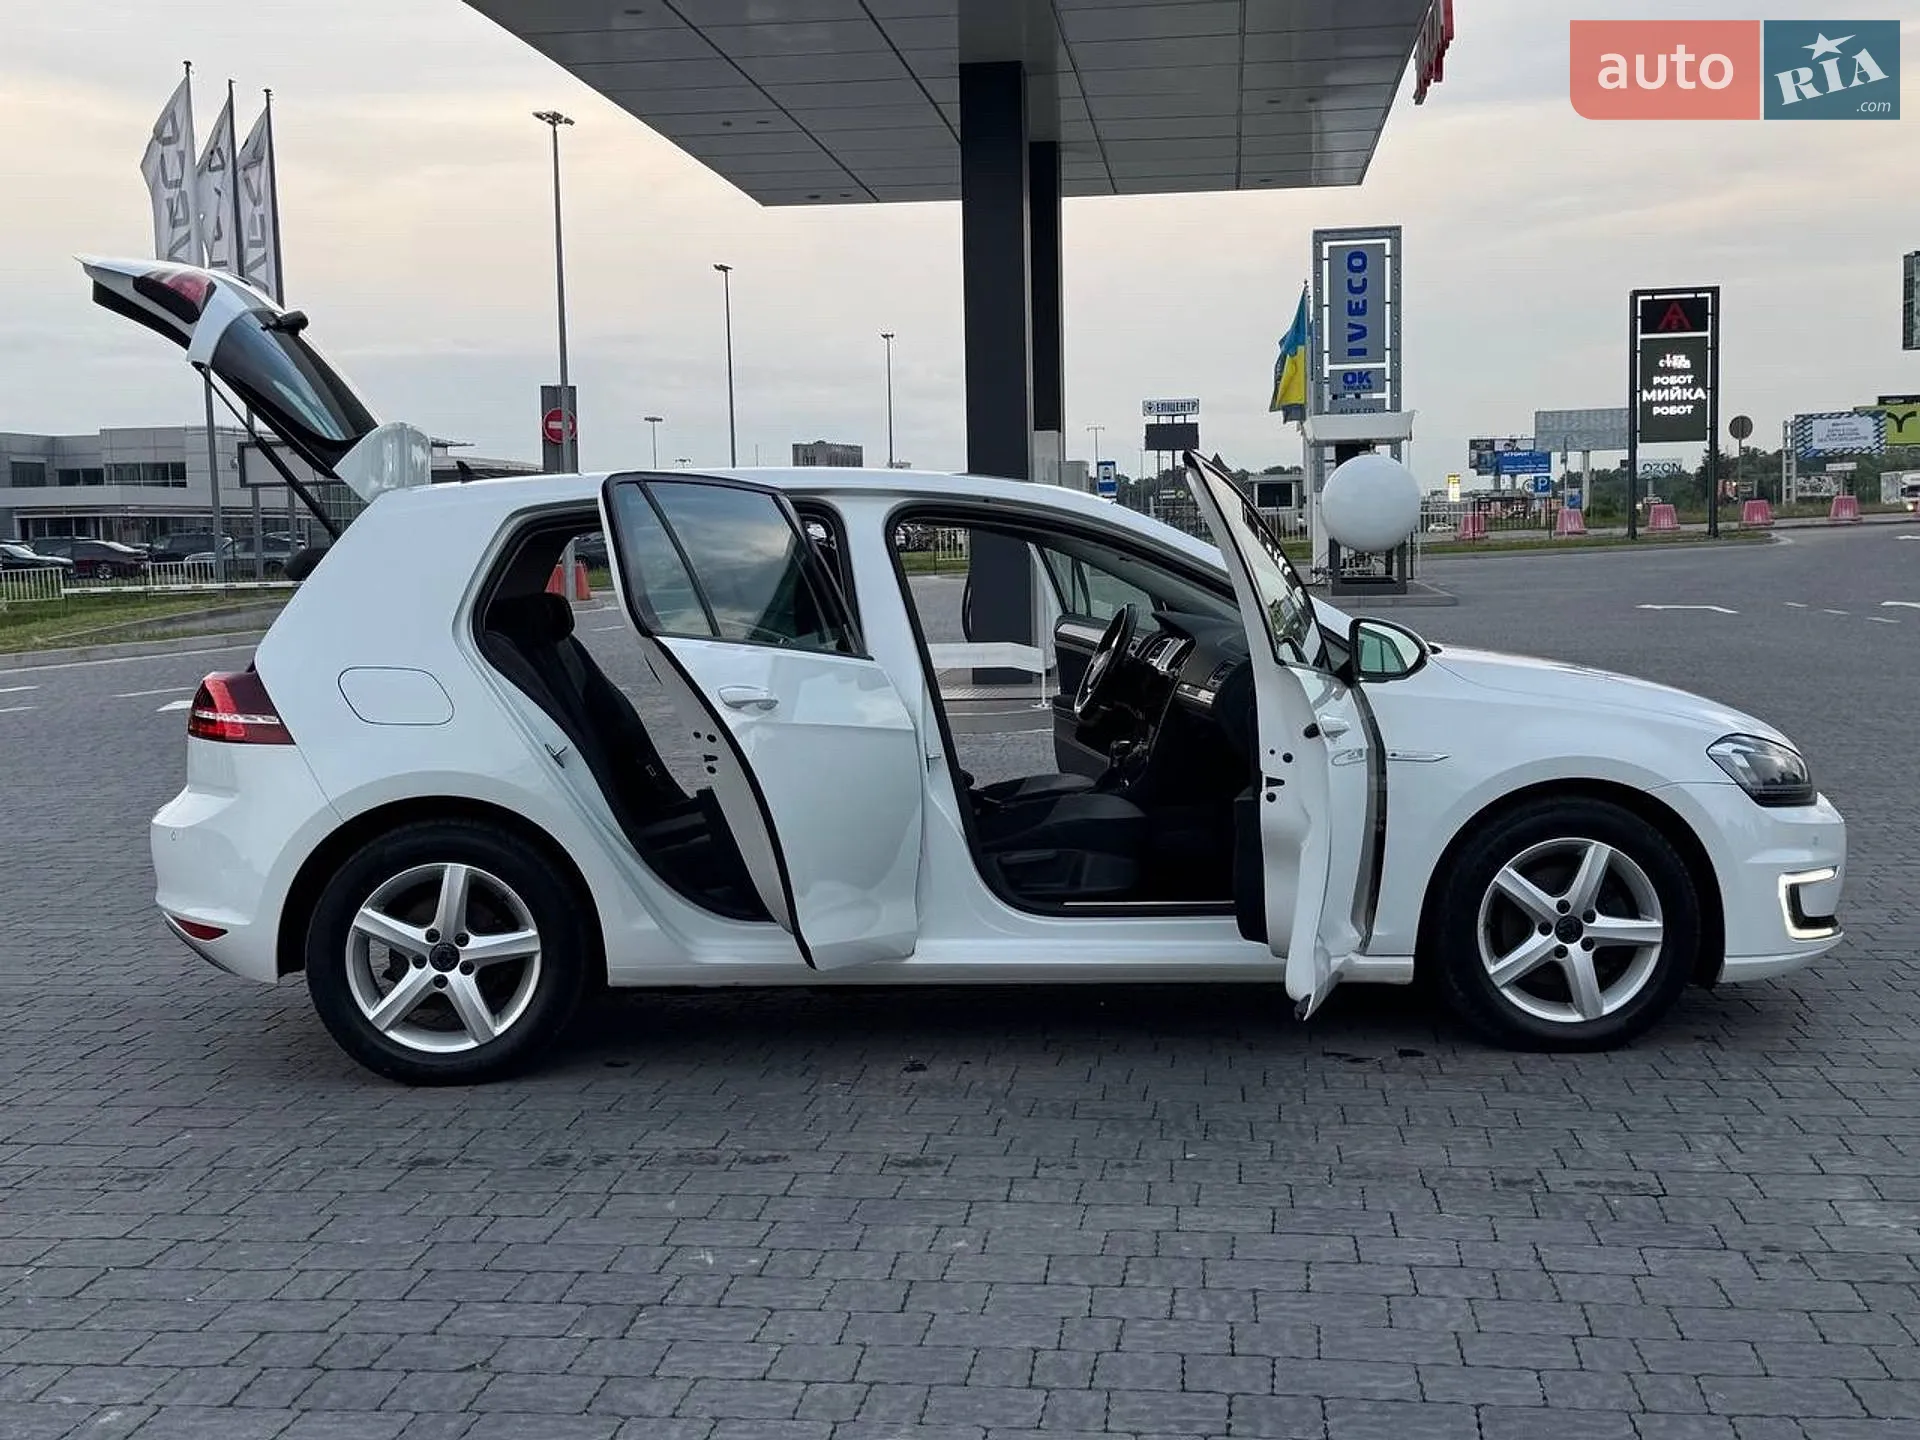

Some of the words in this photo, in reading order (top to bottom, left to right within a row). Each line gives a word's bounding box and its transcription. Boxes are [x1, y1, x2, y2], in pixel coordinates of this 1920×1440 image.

[1346, 250, 1369, 358] IVECO
[1342, 370, 1373, 385] OK
[1652, 374, 1695, 386] РОБОТ
[1641, 385, 1707, 402] МИЙКА
[1652, 404, 1695, 416] РОБОТ
[1537, 477, 1548, 491] P
